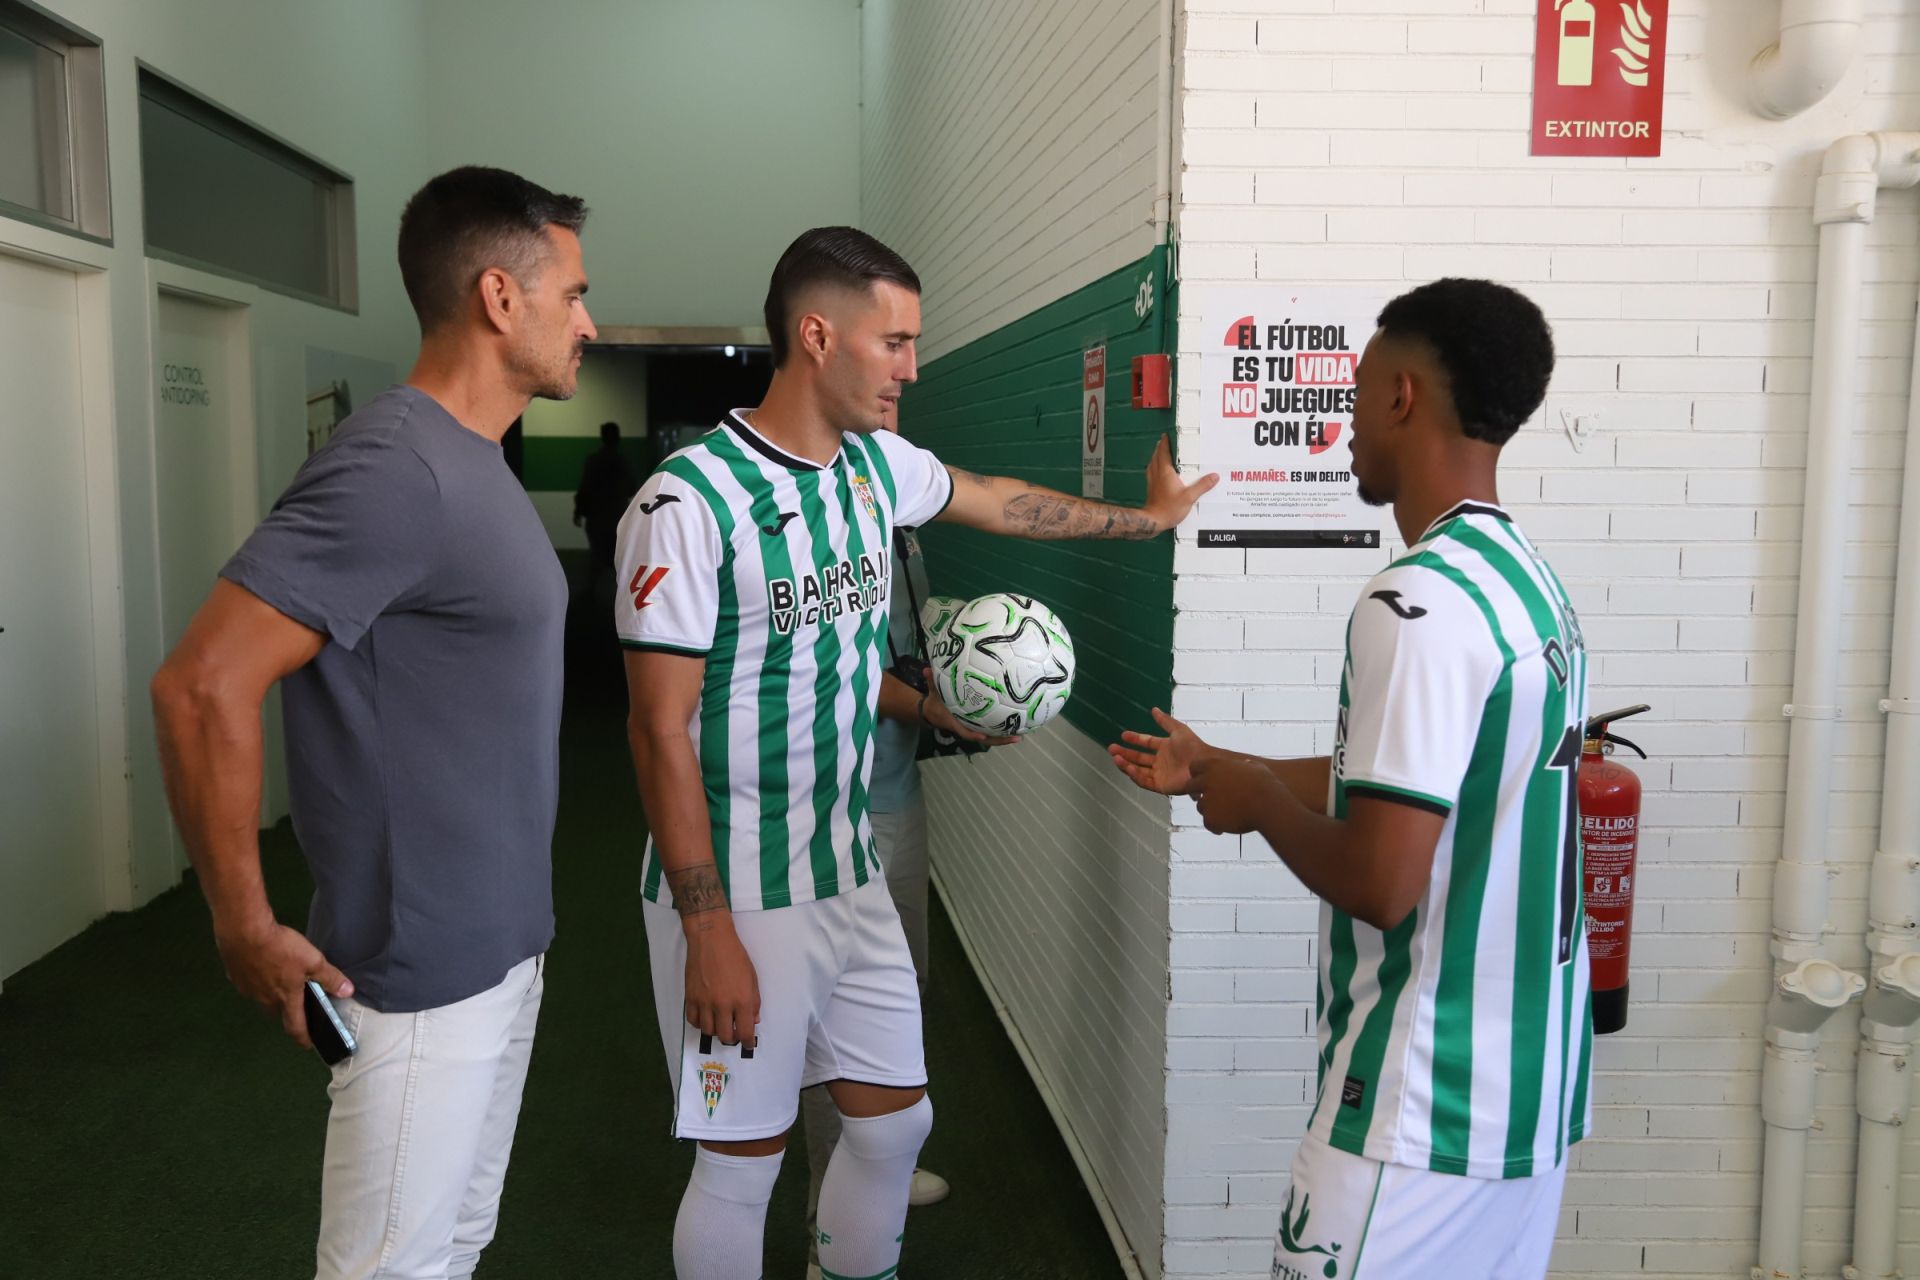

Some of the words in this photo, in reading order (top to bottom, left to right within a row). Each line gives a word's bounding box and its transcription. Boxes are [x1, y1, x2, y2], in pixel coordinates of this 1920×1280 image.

[1545, 120, 1650, 138] EXTINTOR
[1238, 325, 1262, 351] EL
[1267, 318, 1350, 351] FÚTBOL
[164, 364, 204, 385] CONTROL
[1233, 356, 1260, 382] ES
[1265, 356, 1294, 382] TU
[1299, 356, 1354, 383] VIDA
[160, 386, 210, 407] ANTIDOPING
[1224, 387, 1256, 414] NO
[1260, 388, 1357, 414] JUEGUES
[1254, 420, 1300, 446] CON
[1305, 415, 1329, 446] ÉL
[1231, 471, 1244, 482] NO
[1246, 468, 1289, 482] AMAÑES.
[1290, 471, 1302, 482] ES
[1304, 471, 1317, 482] UN
[1319, 471, 1351, 482] DELITO
[774, 582, 887, 632] VICTORIOU
